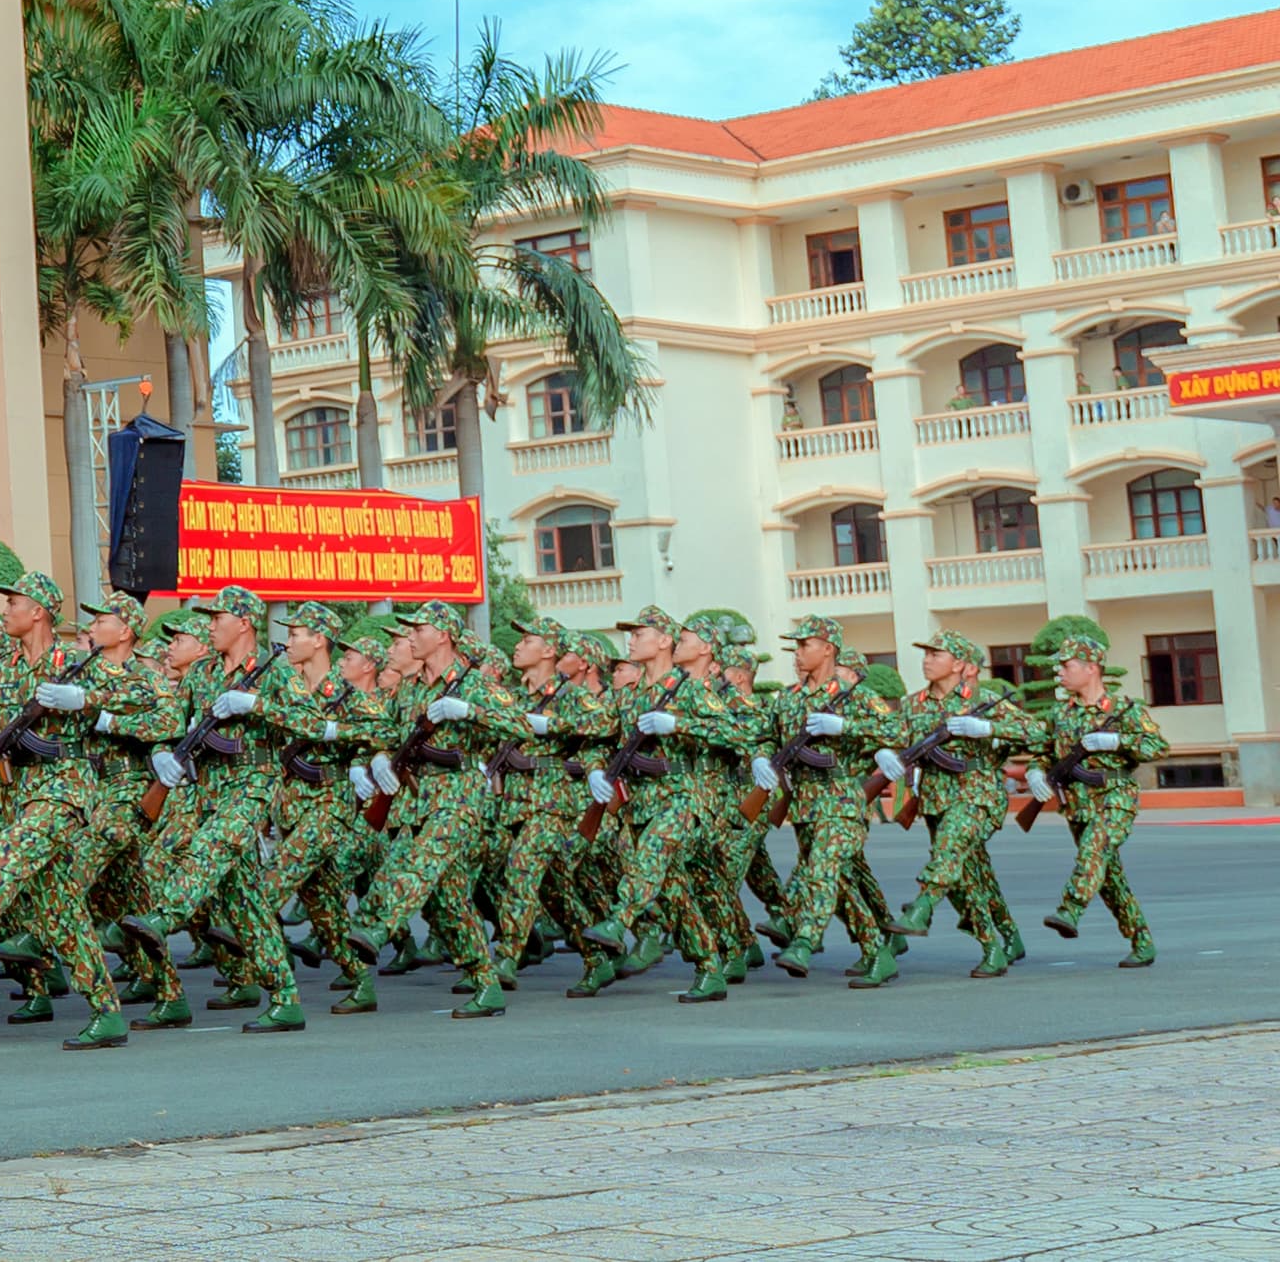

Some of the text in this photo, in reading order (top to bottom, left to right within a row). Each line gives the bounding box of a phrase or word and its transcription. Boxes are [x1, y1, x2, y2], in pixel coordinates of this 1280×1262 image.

[1179, 373, 1210, 399] XÂY
[1213, 369, 1260, 399] DỰNG
[181, 494, 452, 544] TÂM THỰC HIỆN THẮNG LỢI NGHỊ QUYẾT ĐẠI HỘI ĐẢNG BỘ
[188, 548, 211, 584] HỌC
[213, 548, 229, 578] AN
[230, 549, 258, 578] NINH
[259, 544, 290, 579] NHÂN
[290, 545, 314, 579] DÂN
[335, 546, 357, 581] THỨ
[373, 547, 405, 588] NHIỆM
[421, 554, 444, 583] 2020
